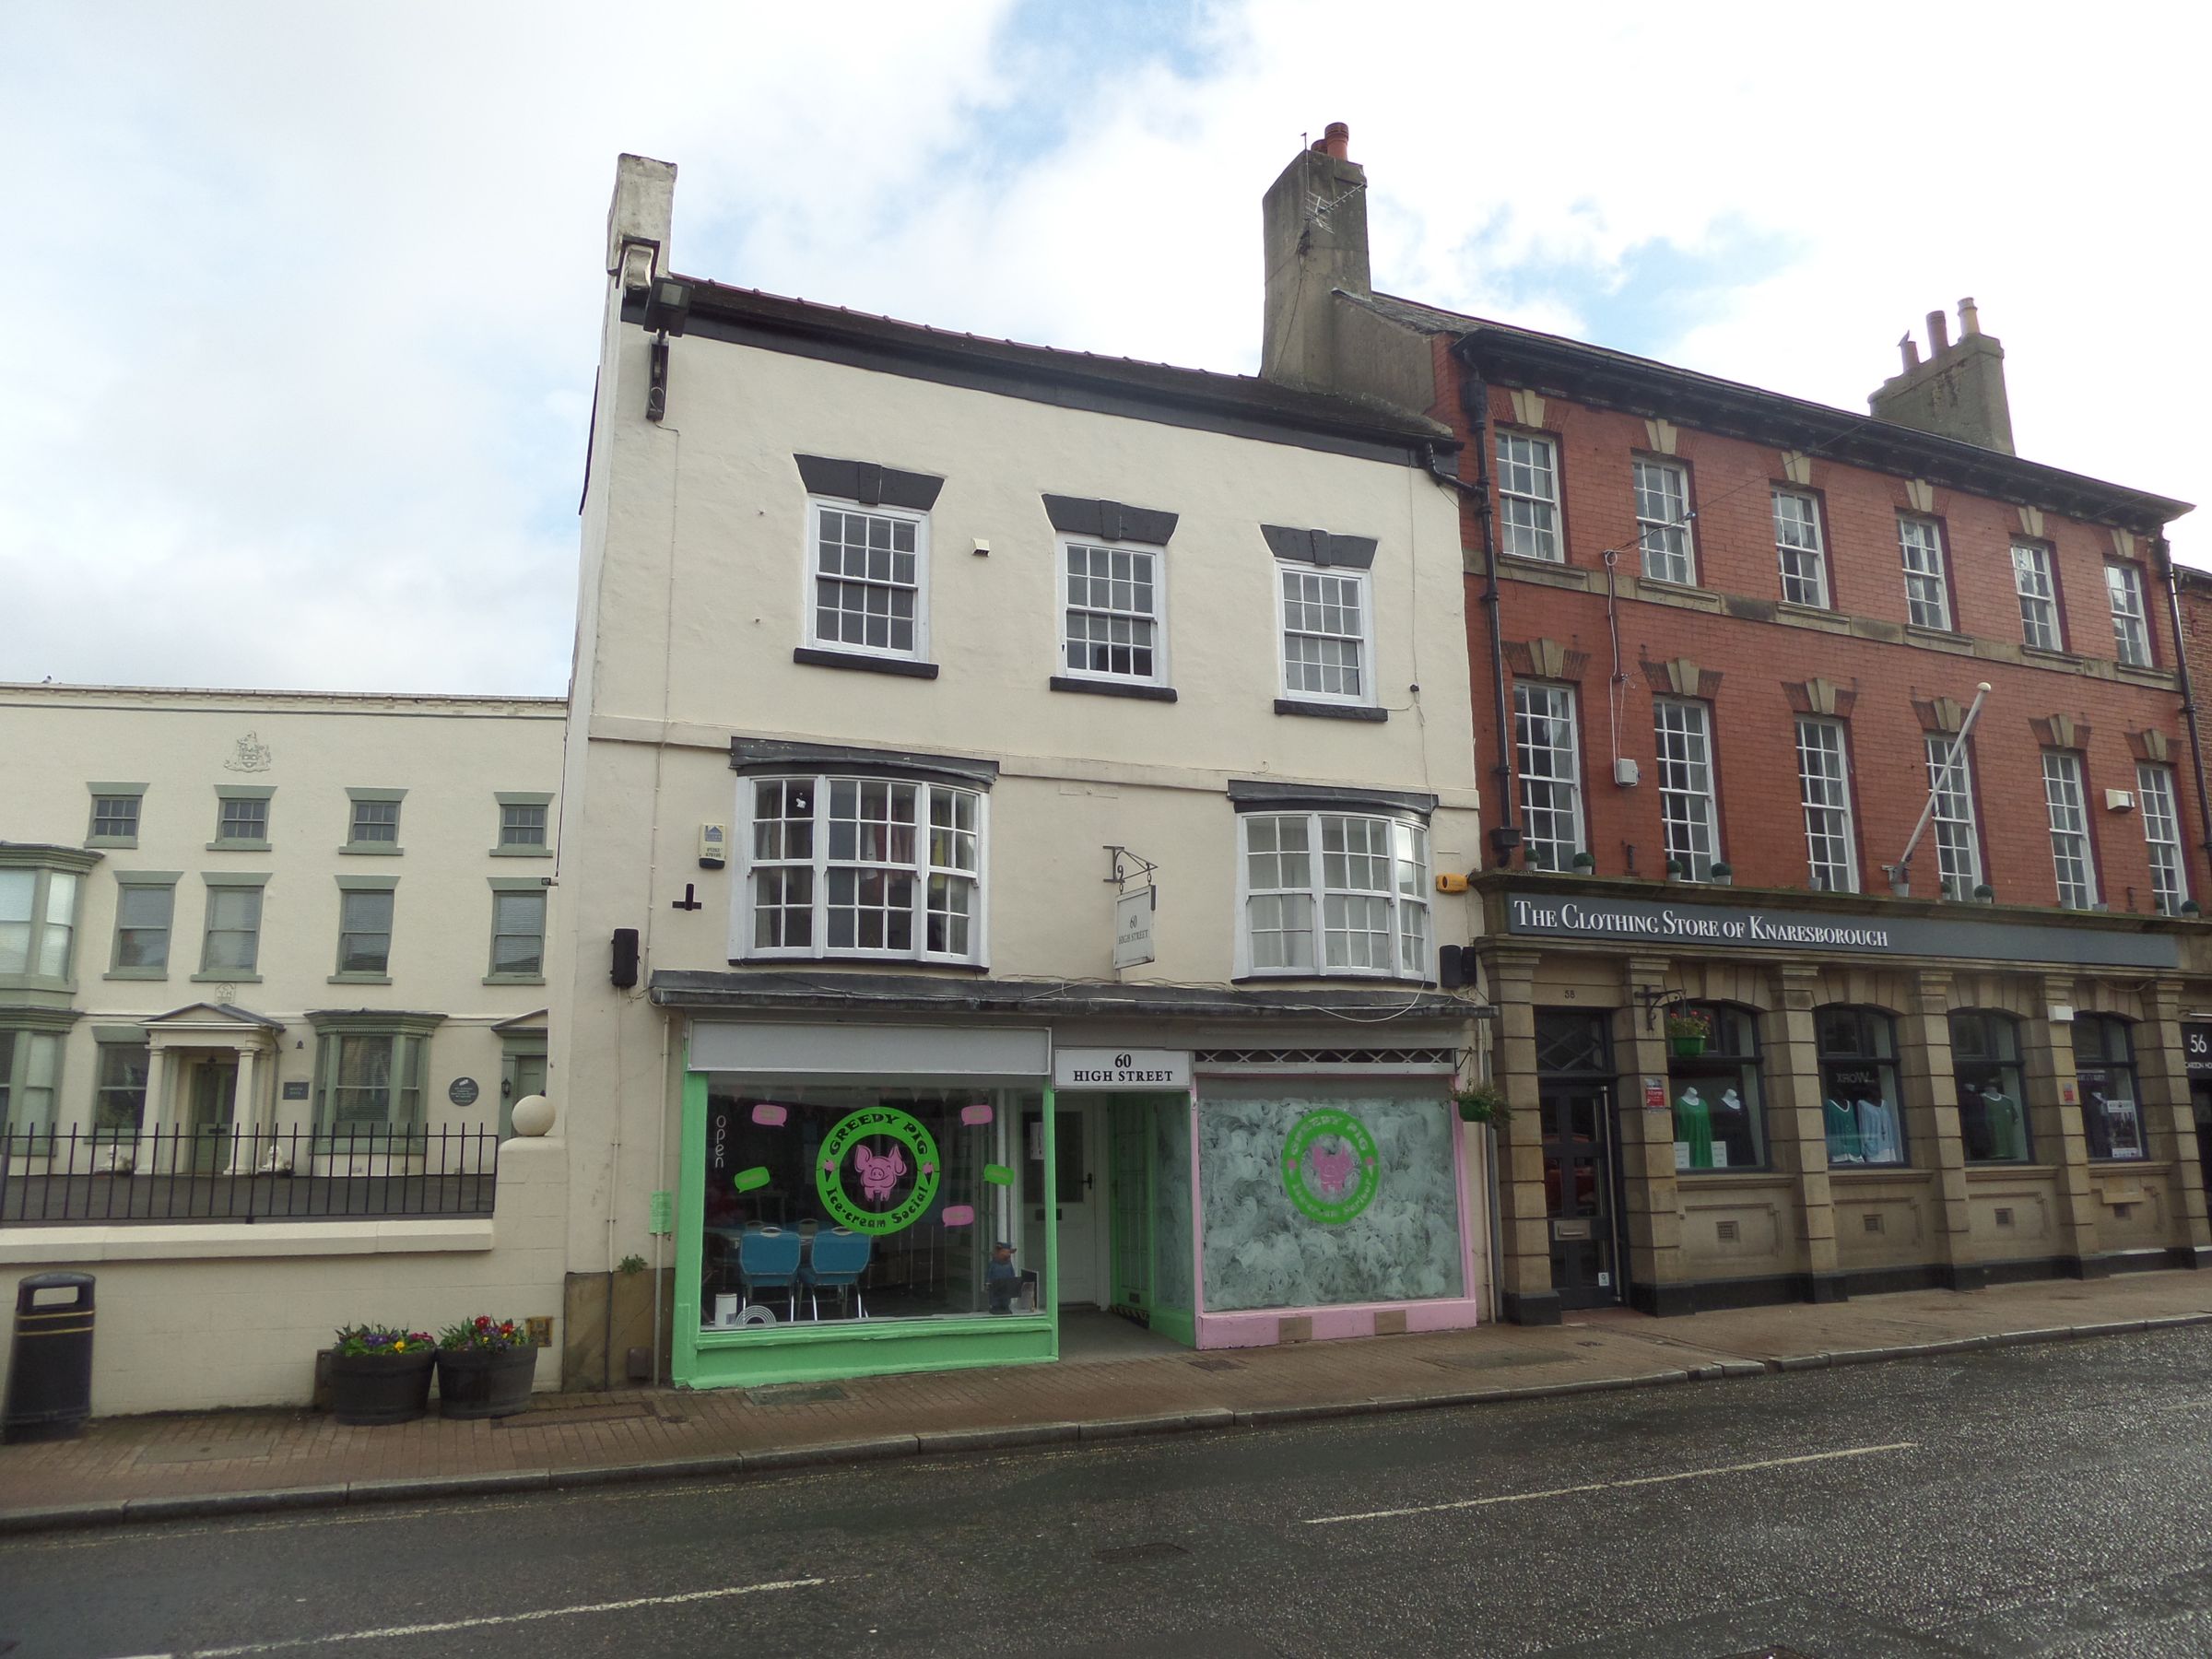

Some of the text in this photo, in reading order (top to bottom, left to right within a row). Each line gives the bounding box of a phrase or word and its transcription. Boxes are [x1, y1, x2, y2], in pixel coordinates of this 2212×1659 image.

[1514, 900, 1888, 947] THE CLOTHING STORE OF KNARESBOROUGH
[1114, 1053, 1132, 1068] 60
[2190, 1033, 2207, 1053] 56
[1073, 1070, 1173, 1082] HIGH STREET
[715, 1114, 726, 1169] open
[829, 1112, 928, 1156] GREEDY PIG
[826, 1185, 929, 1229] Ice-cream Social
